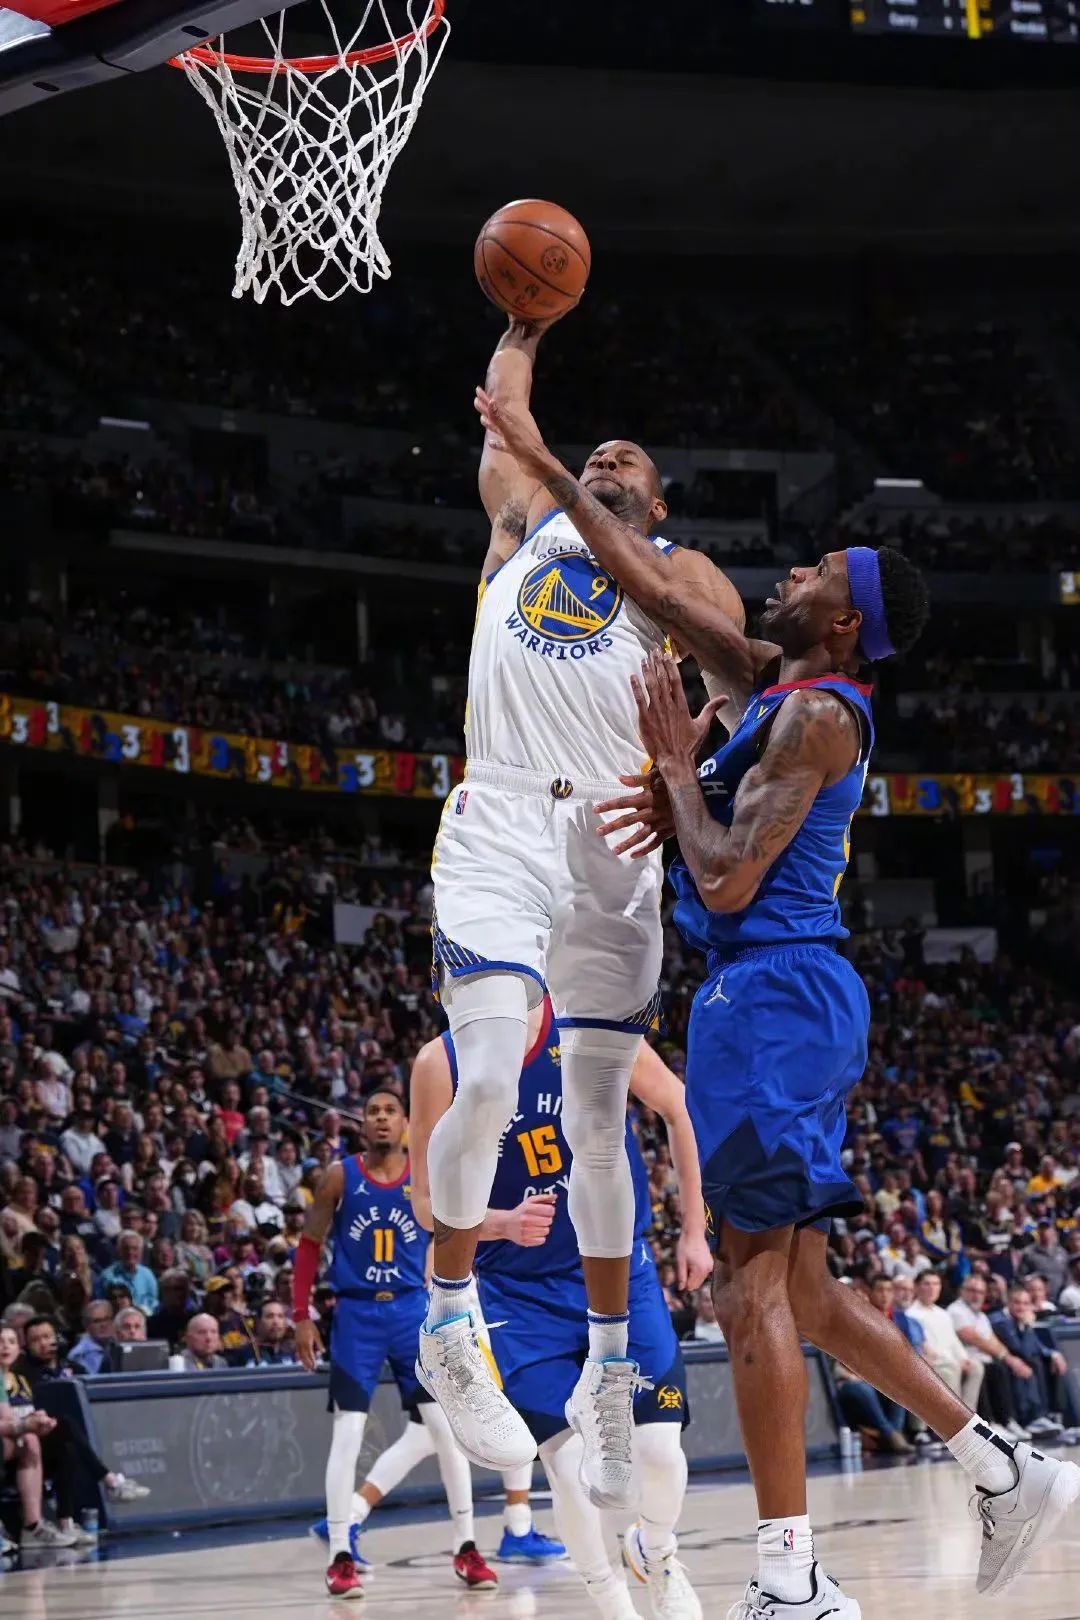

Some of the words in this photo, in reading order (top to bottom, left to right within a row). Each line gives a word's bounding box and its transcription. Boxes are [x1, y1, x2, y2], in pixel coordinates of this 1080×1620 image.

[537, 544, 590, 560] GOLDE
[589, 576, 608, 600] 9
[505, 610, 613, 660] WARRIORS
[122, 725, 140, 758] 3
[356, 755, 375, 786] 3
[696, 757, 729, 796] GH
[537, 1093, 562, 1115] HI
[517, 1125, 562, 1177] 15
[349, 1206, 380, 1242] MILE
[388, 1207, 417, 1243] HIGH
[373, 1228, 394, 1262] 11
[365, 1265, 400, 1283] CITY
